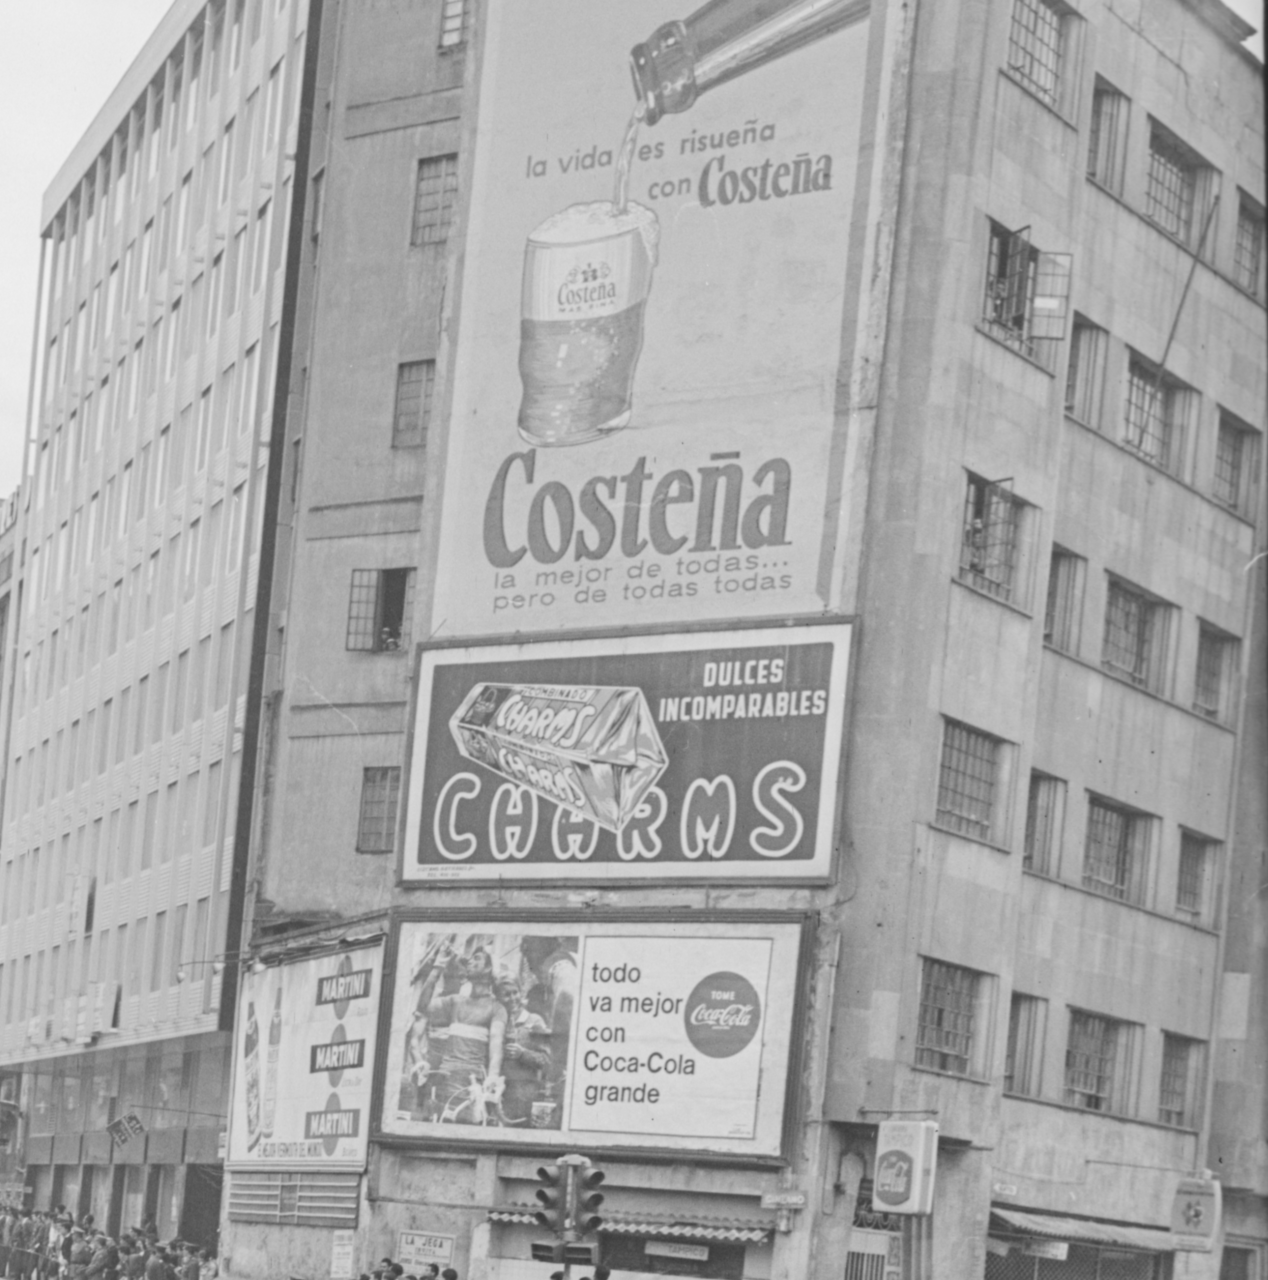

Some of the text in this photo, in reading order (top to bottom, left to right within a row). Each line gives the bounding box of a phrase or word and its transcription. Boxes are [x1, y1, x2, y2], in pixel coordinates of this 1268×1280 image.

[526, 119, 777, 178] la vida es risueña
[648, 152, 834, 208] con Costeña
[557, 282, 617, 306] Costeña
[483, 448, 794, 569] Costeña
[494, 552, 789, 592] la mejor de todas...
[493, 570, 792, 613] pero de todas todas
[703, 658, 785, 687] DULCES
[497, 694, 597, 747] CHARMS
[658, 690, 827, 722] INCOMPARABLES
[498, 748, 586, 808] CHARMS
[434, 760, 807, 861] CHARMS
[322, 973, 366, 1002] MARTINI
[591, 962, 641, 985] todo
[589, 987, 684, 1020] va mejor
[710, 990, 735, 1000] TOME
[690, 1003, 755, 1027] Coca-Cola
[586, 1024, 626, 1044] con
[316, 1042, 360, 1069] MARTINI
[583, 1050, 697, 1077] Coca-Cola
[584, 1082, 661, 1108] grande
[310, 1112, 354, 1137] MARTINI
[405, 1236, 415, 1245] LA
[667, 1244, 706, 1258] TAMPICO
